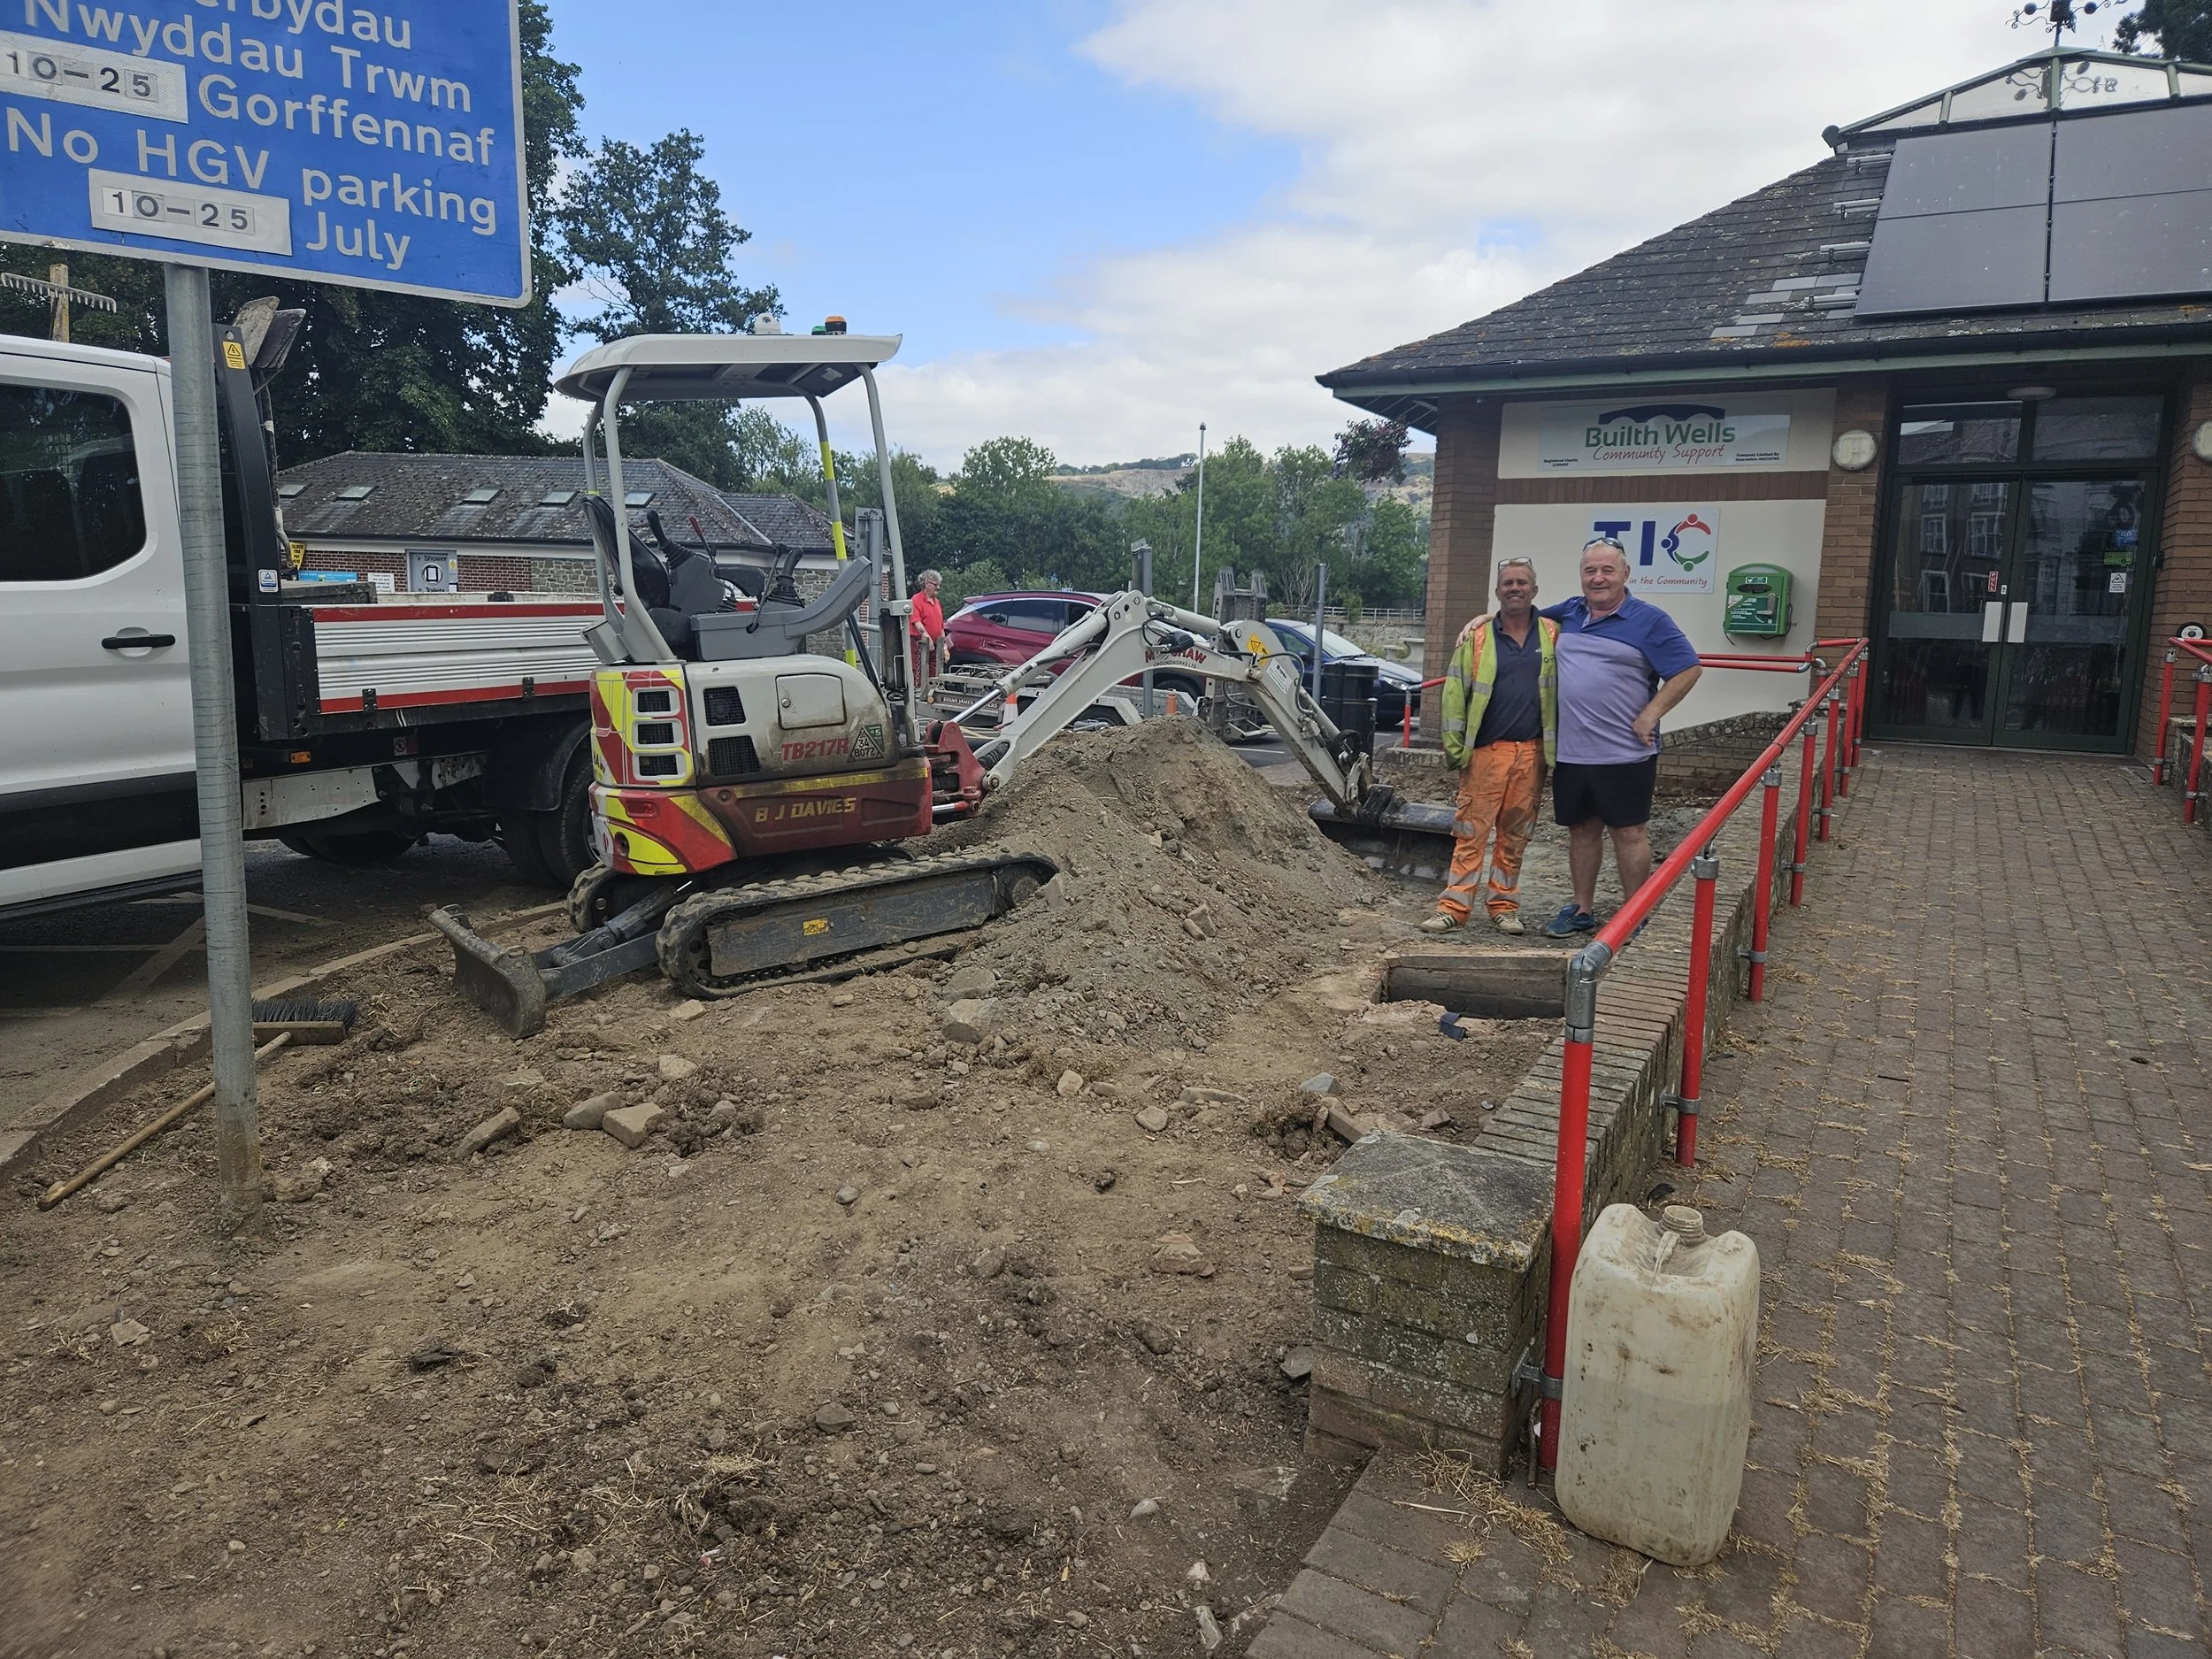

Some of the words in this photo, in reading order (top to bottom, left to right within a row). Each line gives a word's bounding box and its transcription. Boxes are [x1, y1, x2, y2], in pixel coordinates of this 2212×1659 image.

[25, 0, 303, 81] Nwyddau
[331, 45, 471, 113] Trwm
[6, 50, 152, 97] 10-25
[198, 73, 495, 166] Gorffennaf
[7, 106, 99, 165] No
[137, 128, 270, 190] HGV
[303, 167, 497, 236] parking
[110, 190, 249, 232] 10-25
[306, 211, 411, 271] July
[1586, 425, 1659, 448] Builth
[1665, 422, 1736, 444] Wells
[1593, 446, 1667, 465] Community
[1671, 443, 1725, 465] Support
[1629, 576, 1637, 585] in
[1640, 575, 1654, 585] the
[1656, 575, 1708, 588] Community
[781, 736, 849, 761] TB217R
[755, 807, 769, 823] B
[774, 805, 786, 821] J
[790, 797, 857, 818] DAVIES
